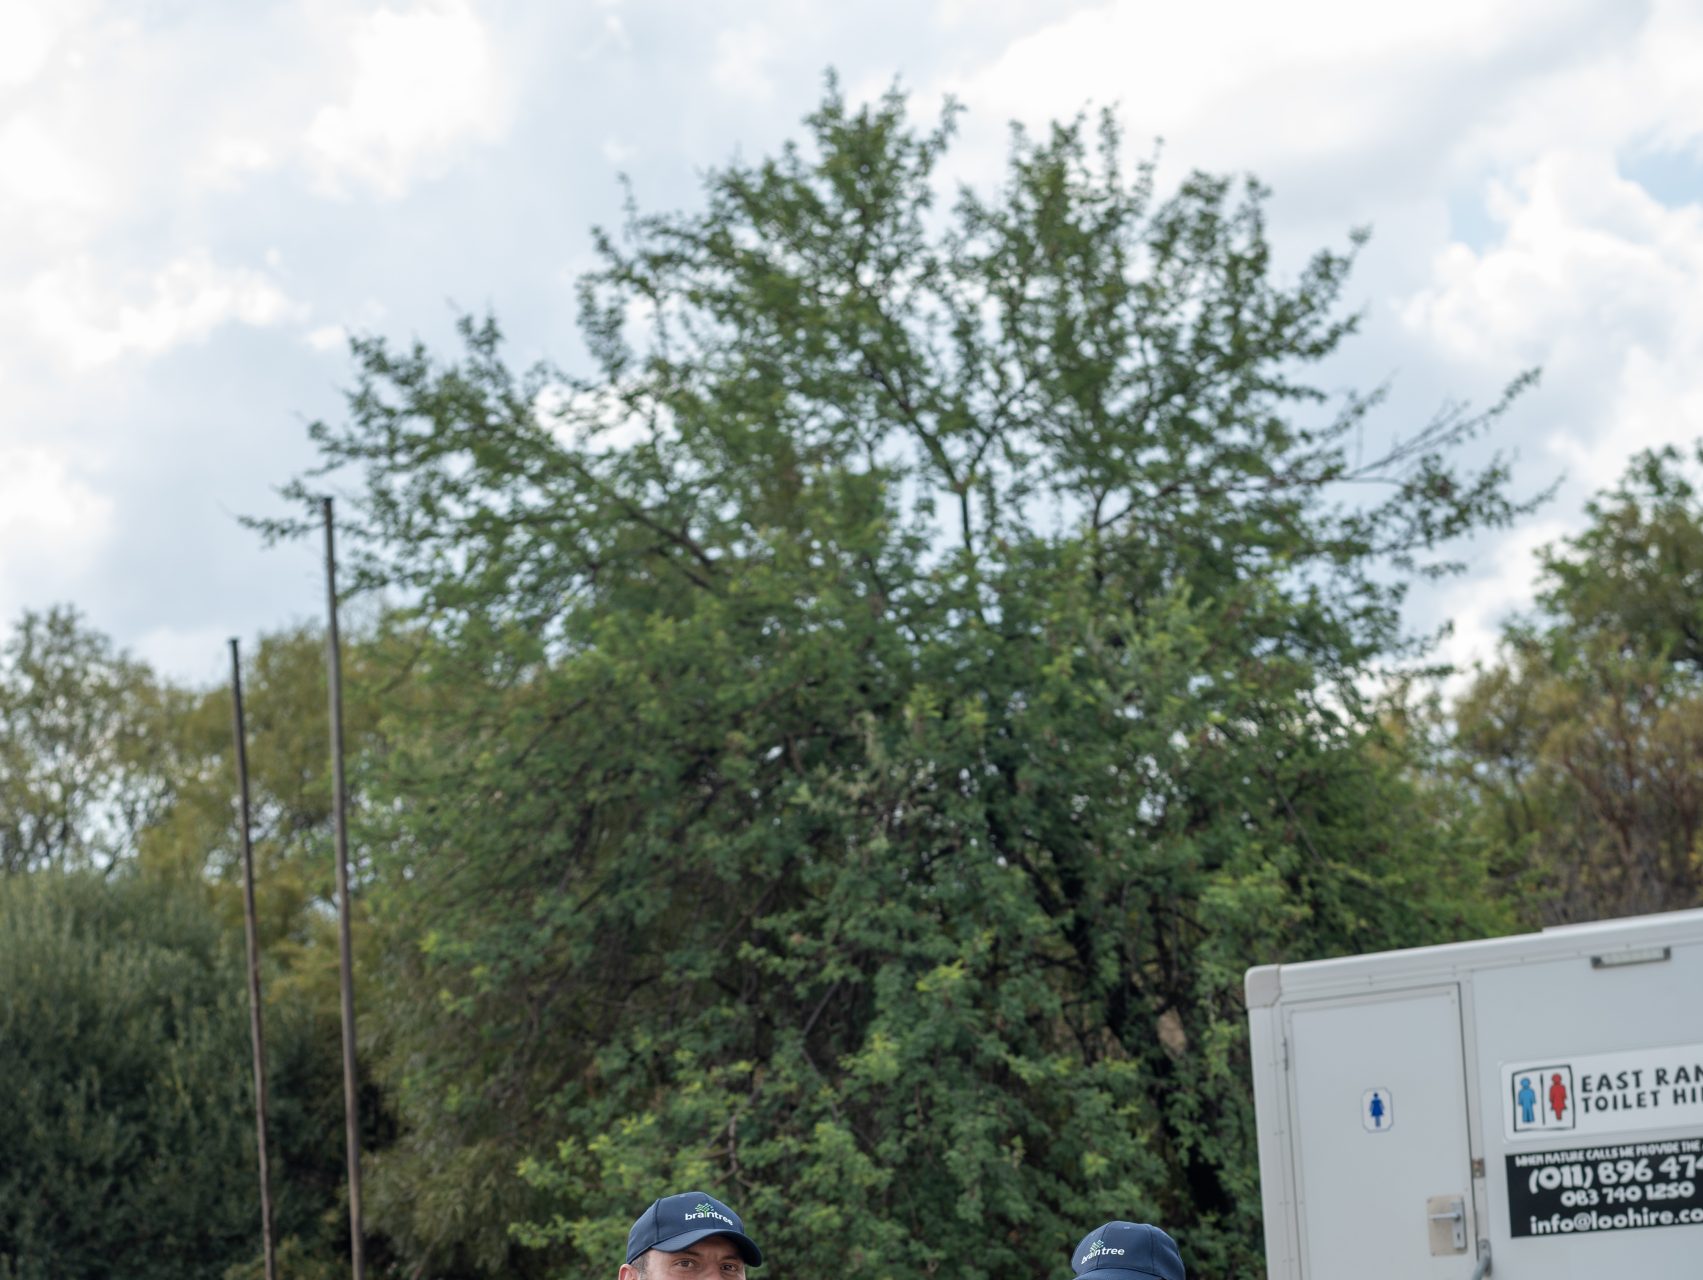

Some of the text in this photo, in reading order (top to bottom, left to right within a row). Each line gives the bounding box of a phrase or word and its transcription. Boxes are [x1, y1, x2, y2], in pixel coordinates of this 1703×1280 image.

[1581, 1070, 1643, 1093] EAST
[1582, 1087, 1703, 1113] TOILET HI
[1586, 1147, 1618, 1161] CALLS
[1529, 1163, 1594, 1194] (011)
[1598, 1157, 1654, 1185] 896
[1561, 1181, 1695, 1207] 083 740 1250
[685, 1211, 734, 1226] braintree
[1530, 1207, 1703, 1235] info@loohire.co
[1081, 1247, 1125, 1265] braintree
